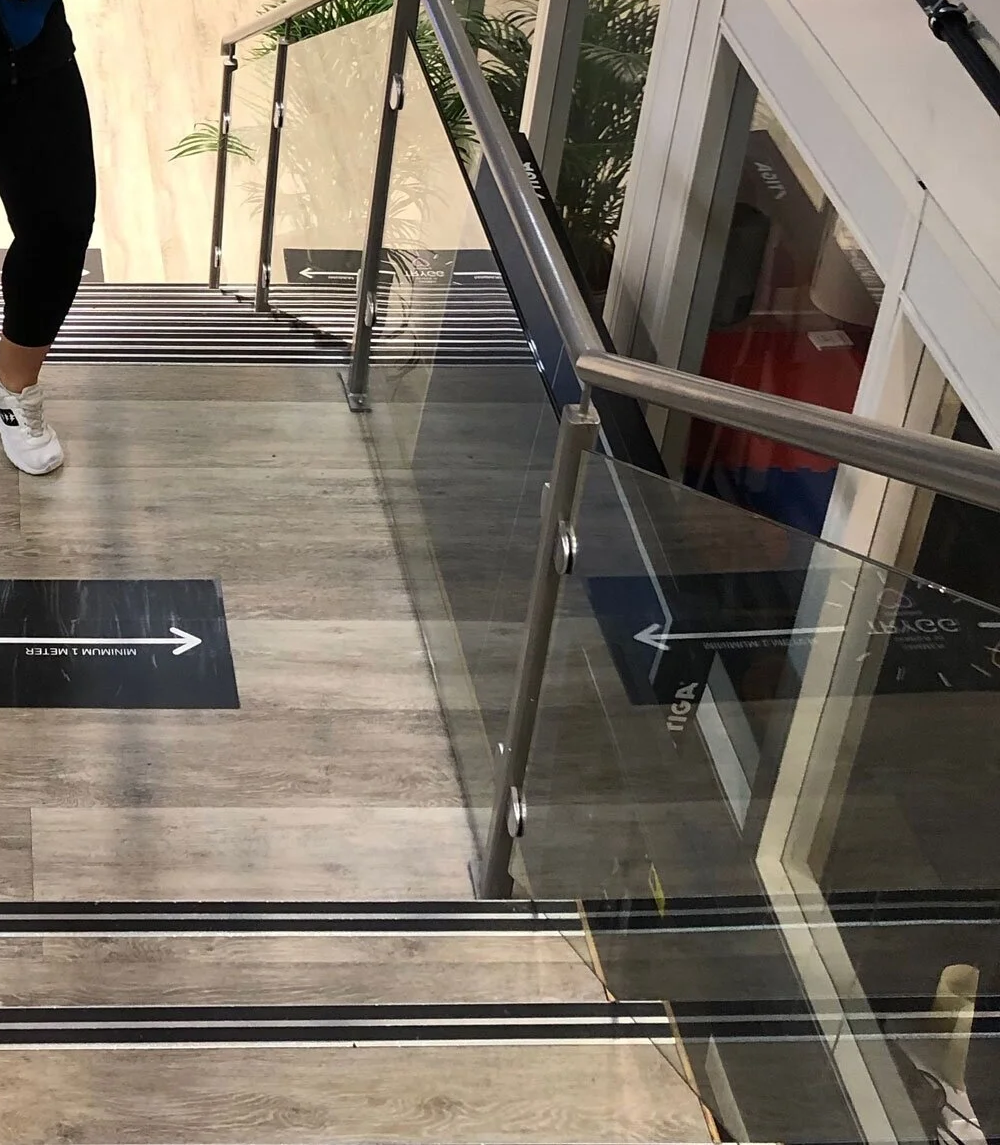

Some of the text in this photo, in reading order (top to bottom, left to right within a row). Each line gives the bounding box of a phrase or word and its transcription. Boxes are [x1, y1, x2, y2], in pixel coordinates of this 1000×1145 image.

[25, 648, 137, 656] MINIMUM 1 METER
